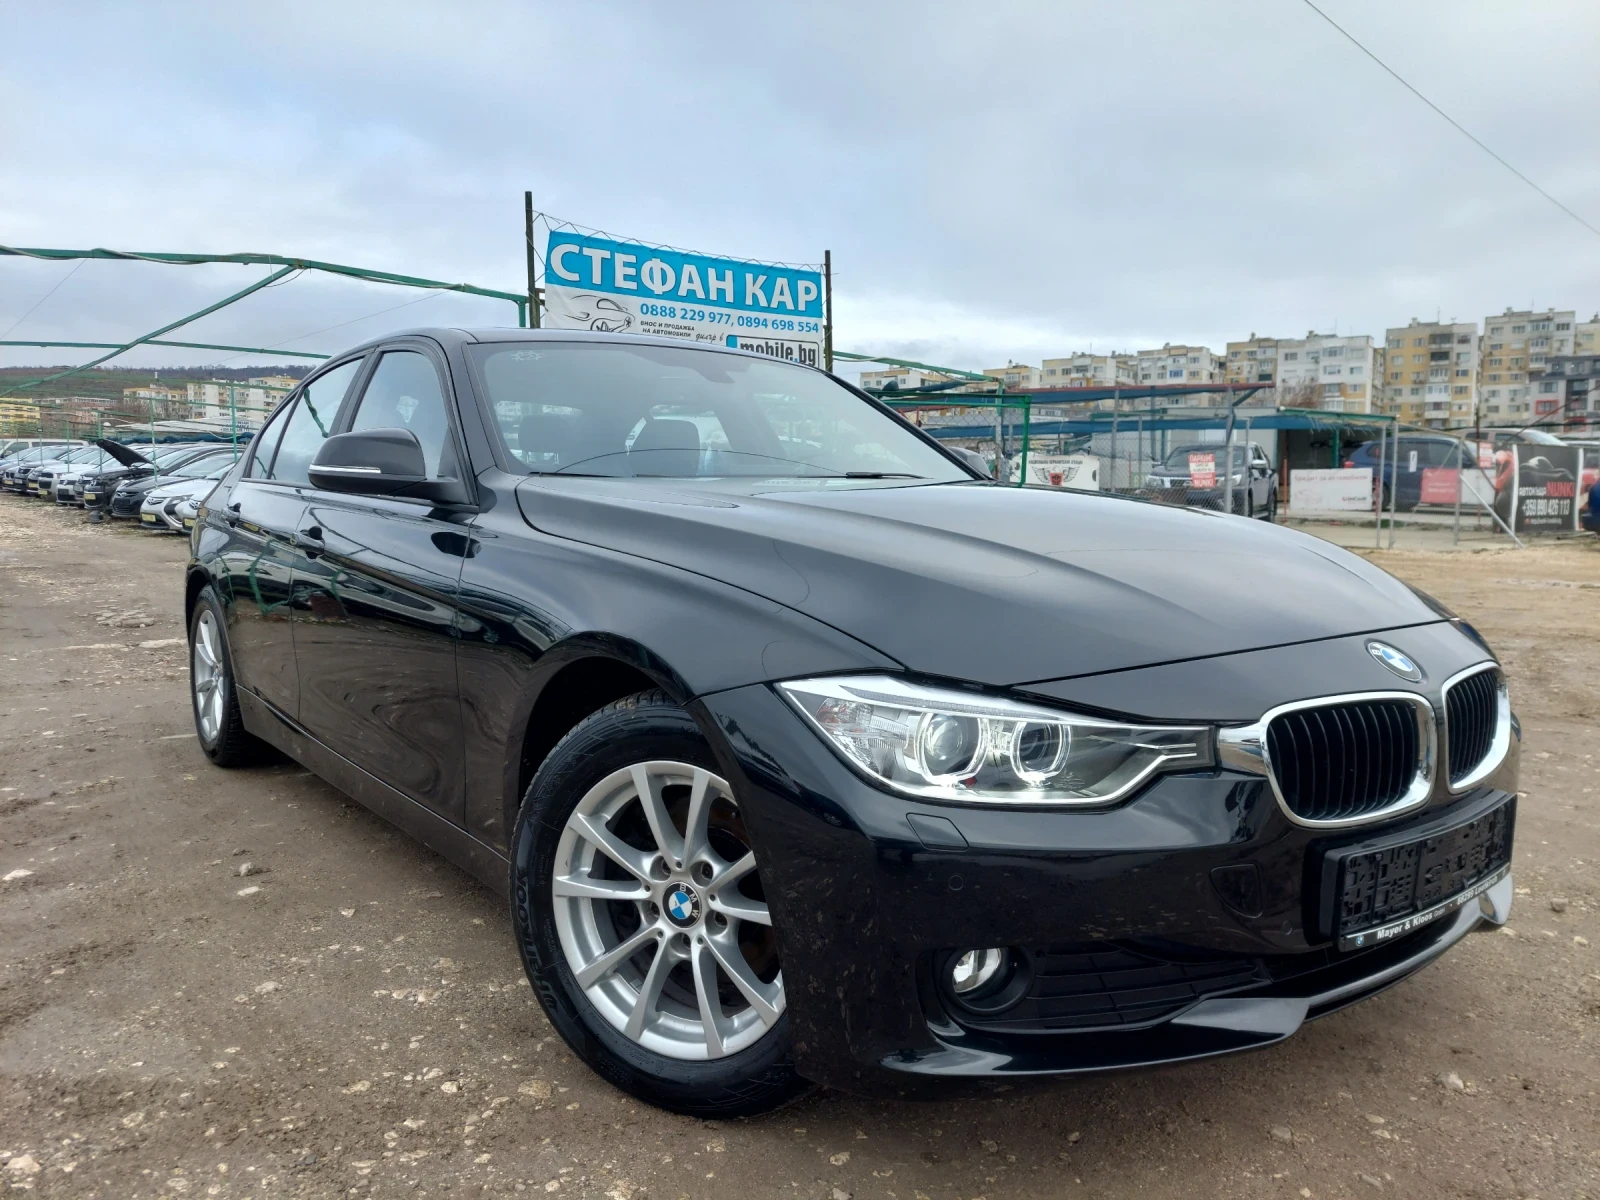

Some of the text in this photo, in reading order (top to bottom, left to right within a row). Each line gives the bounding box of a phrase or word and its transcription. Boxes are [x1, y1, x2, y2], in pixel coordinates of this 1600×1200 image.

[550, 243, 819, 313] СТЕФАН КАР
[640, 303, 819, 334] 0888 229 977, 0894 698 554
[664, 323, 695, 332] ПРОДАЖБА
[652, 328, 692, 337] АВТОМОБИЛИ
[1522, 499, 1536, 516] +359
[1377, 925, 1403, 939] Mayer
[1404, 920, 1410, 930] &
[1412, 912, 1432, 927] Kloos
